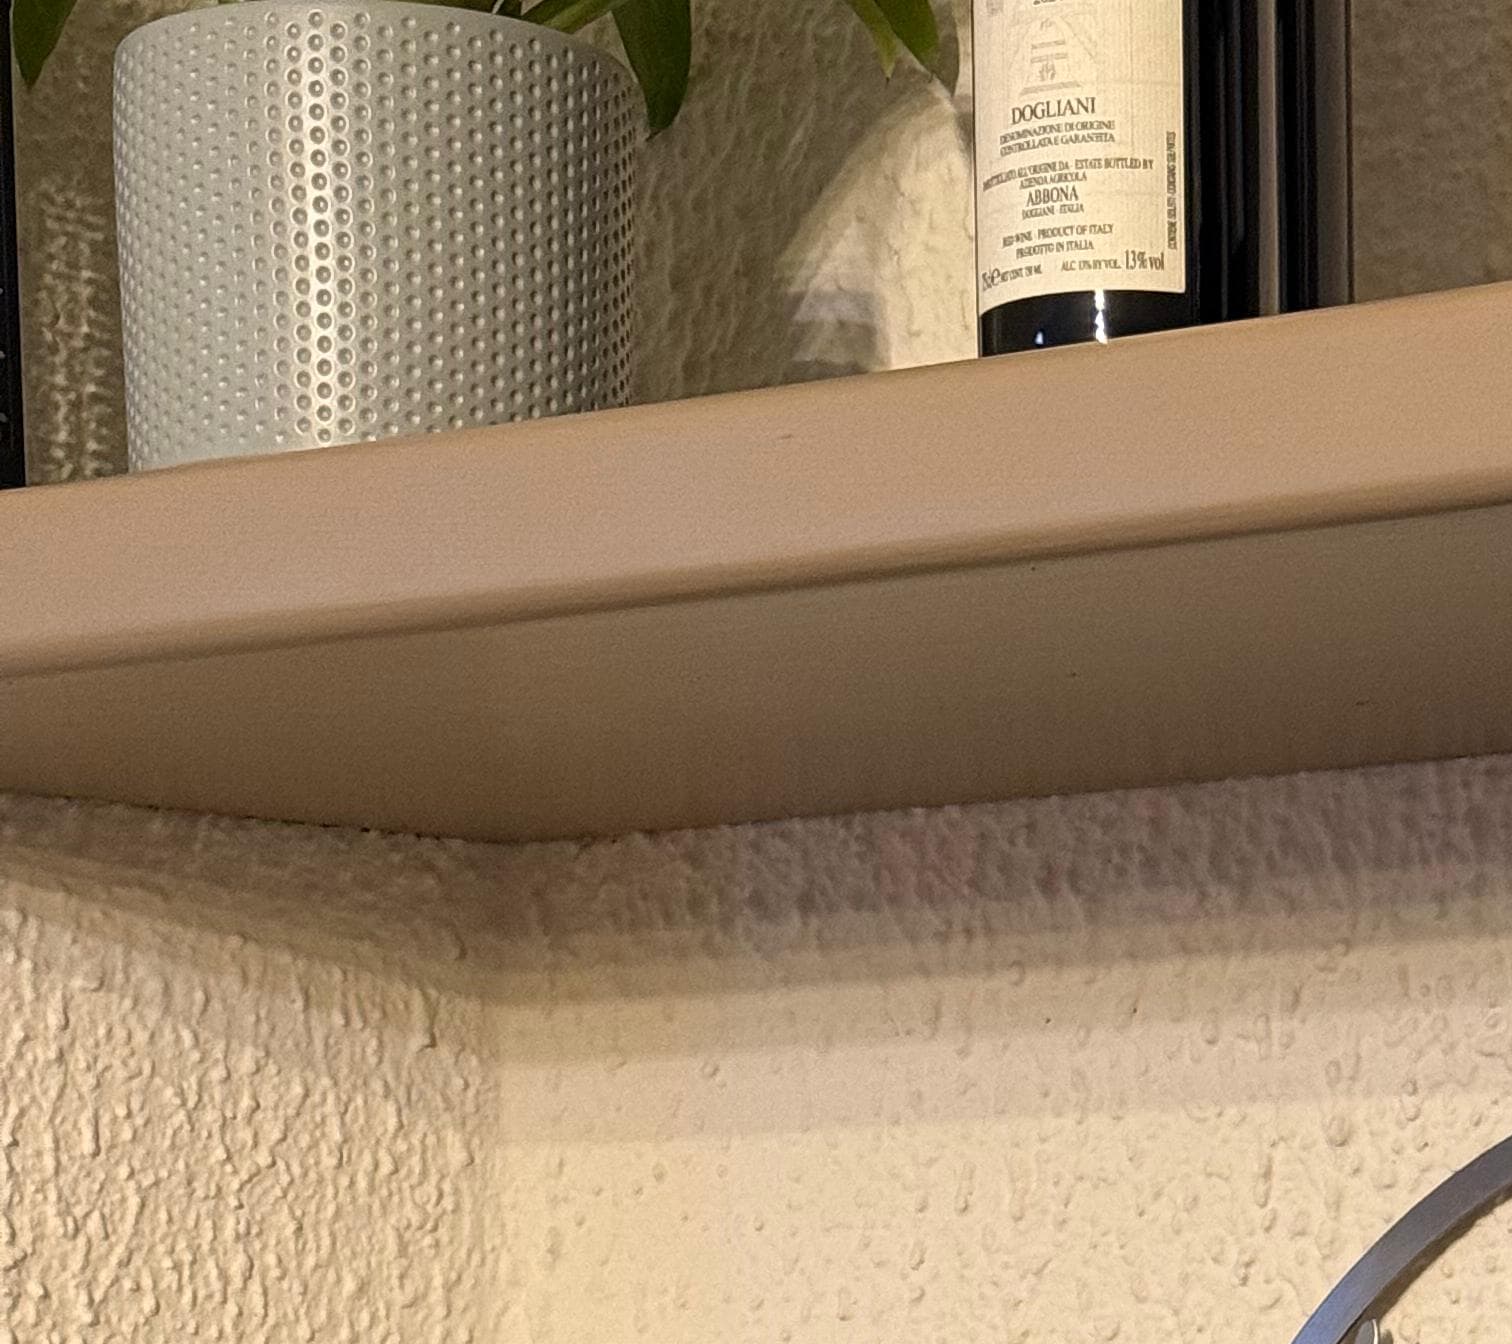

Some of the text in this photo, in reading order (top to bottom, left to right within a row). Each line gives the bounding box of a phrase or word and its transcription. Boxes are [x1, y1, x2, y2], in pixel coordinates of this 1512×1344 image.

[1012, 97, 1096, 125] DOGLIANI
[1076, 120, 1115, 131] ORIGINE
[1075, 158, 1102, 170] ESTATE
[1104, 158, 1141, 170] BOTTLED
[1142, 158, 1154, 170] BY
[1026, 185, 1079, 207] ABBONA
[1038, 225, 1074, 240] PRODUCT
[1076, 224, 1087, 235] OF
[1089, 223, 1114, 235] ITALY
[1125, 249, 1165, 271] 13% vol
